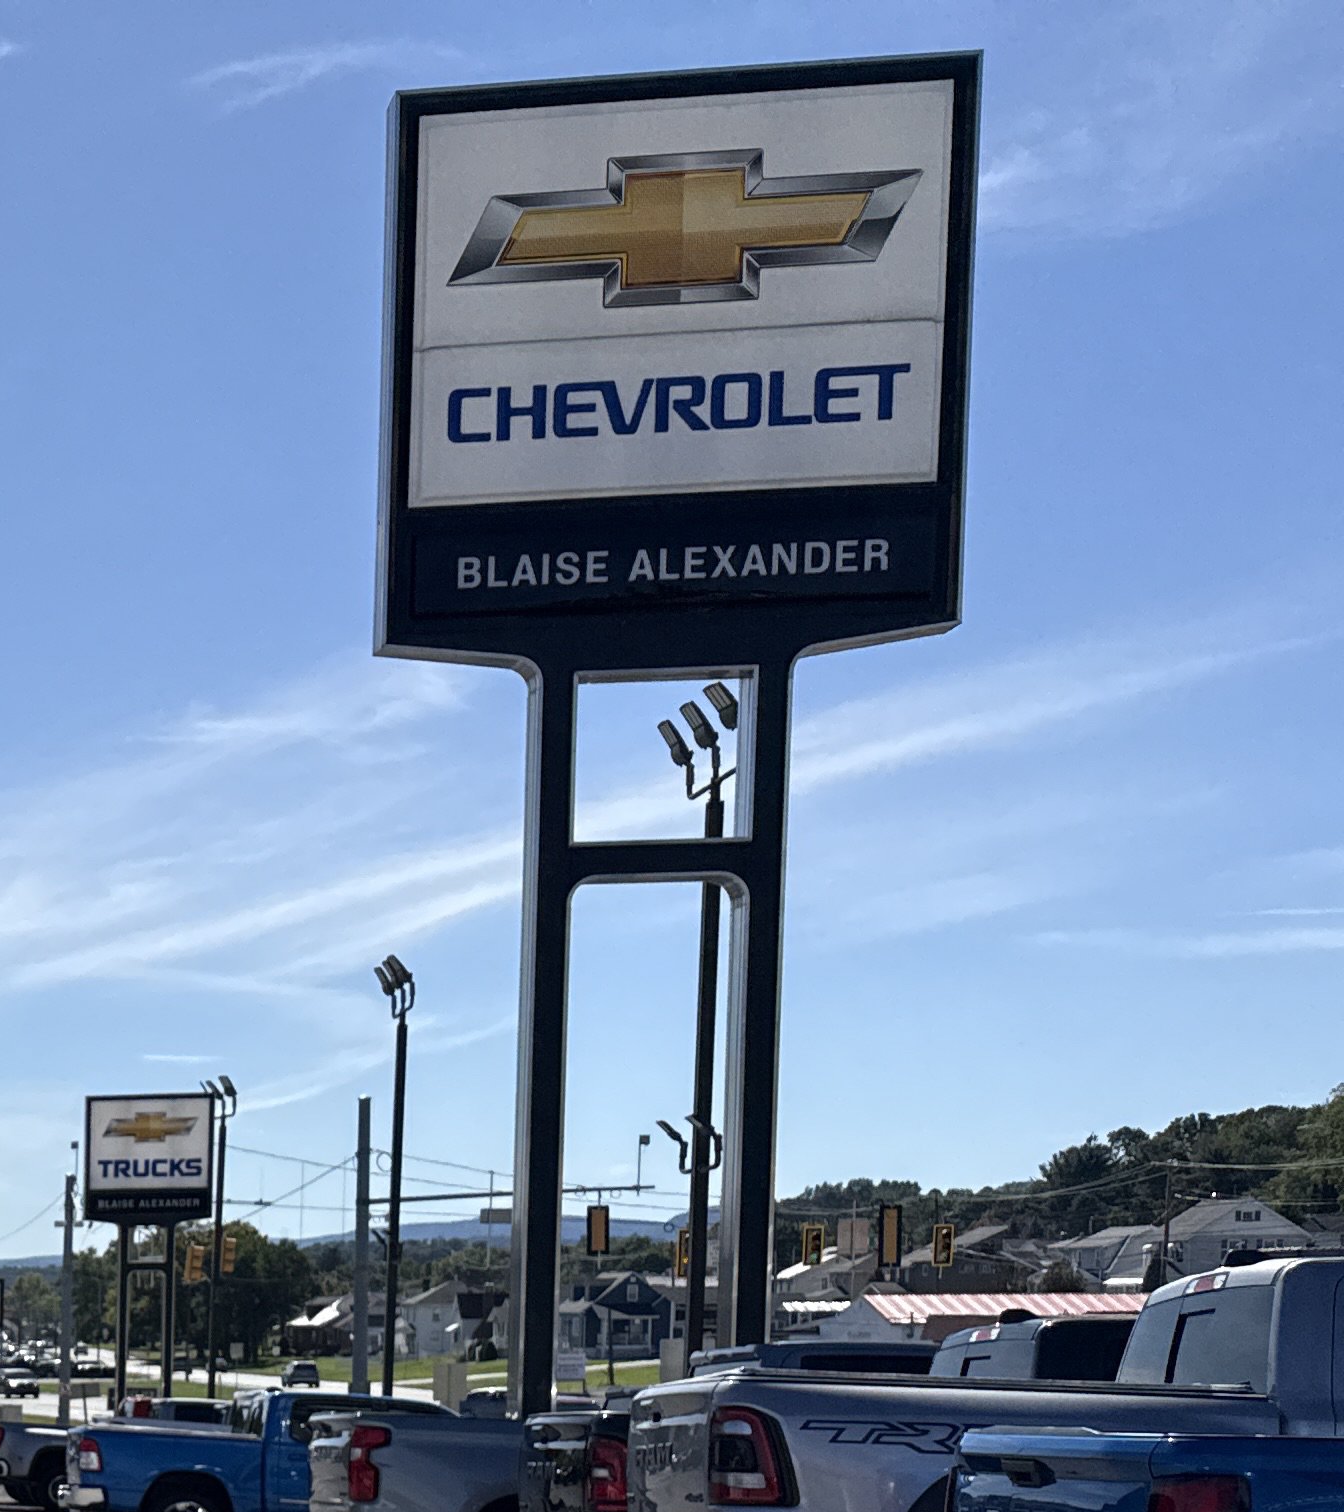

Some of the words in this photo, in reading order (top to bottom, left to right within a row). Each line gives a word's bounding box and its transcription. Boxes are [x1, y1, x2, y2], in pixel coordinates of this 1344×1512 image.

[447, 363, 911, 443] CHEVROLET
[457, 550, 609, 590] BLAISE
[628, 538, 890, 583] ALEXANDER
[98, 1158, 203, 1178] TRUCKS
[97, 1199, 135, 1209] BLAISE
[138, 1198, 200, 1208] ALEXANDER
[799, 1419, 962, 1455] TR
